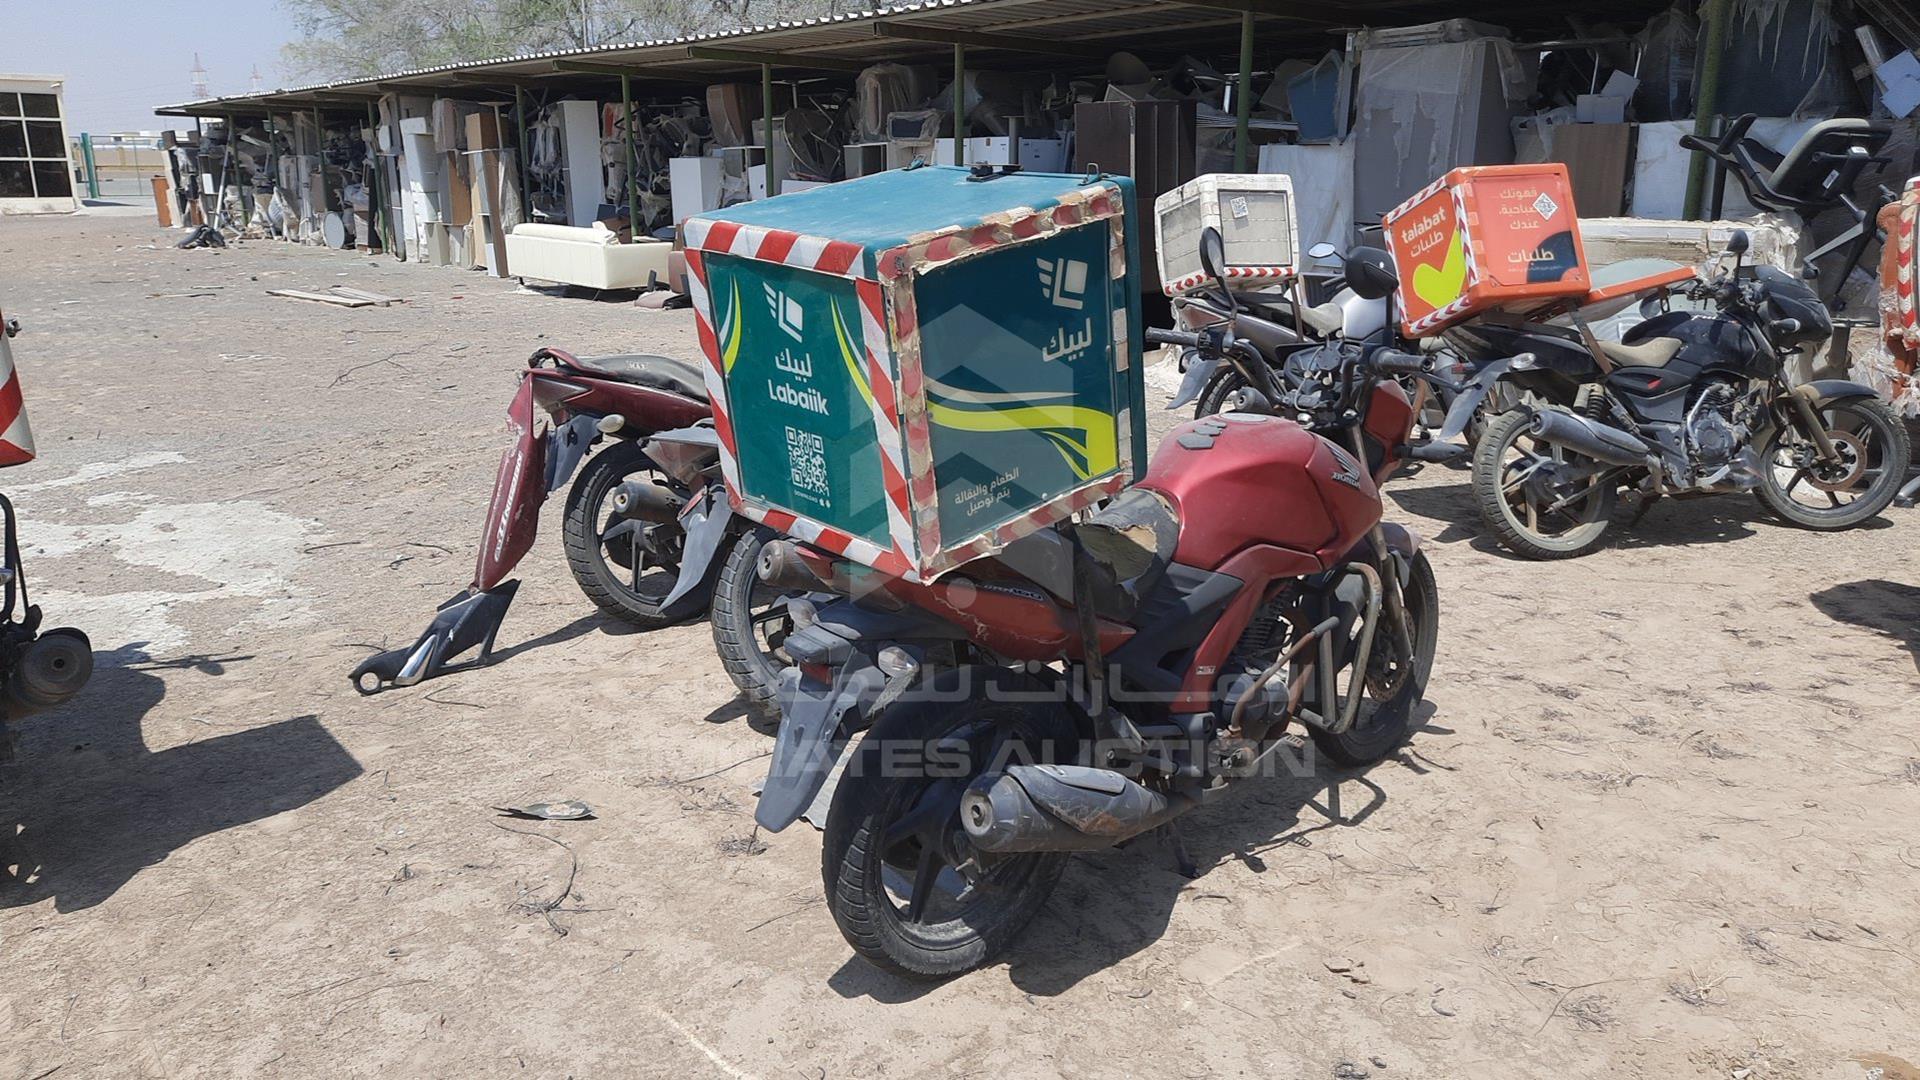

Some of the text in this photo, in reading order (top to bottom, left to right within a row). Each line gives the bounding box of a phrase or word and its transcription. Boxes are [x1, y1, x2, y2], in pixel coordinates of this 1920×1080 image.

[1499, 186, 1538, 201] قهوتك
[1402, 206, 1446, 244] talabat
[1510, 218, 1541, 230] عندك
[1410, 231, 1444, 258] طلبات
[1507, 247, 1555, 265] طلبات
[1041, 316, 1093, 363] لبيك
[774, 347, 813, 379] لبيك
[767, 378, 830, 417] Labaiik
[953, 466, 1020, 505] الطعام والبقالة
[1331, 471, 1361, 490] HONDA
[966, 487, 1011, 518] يتم توصيل
